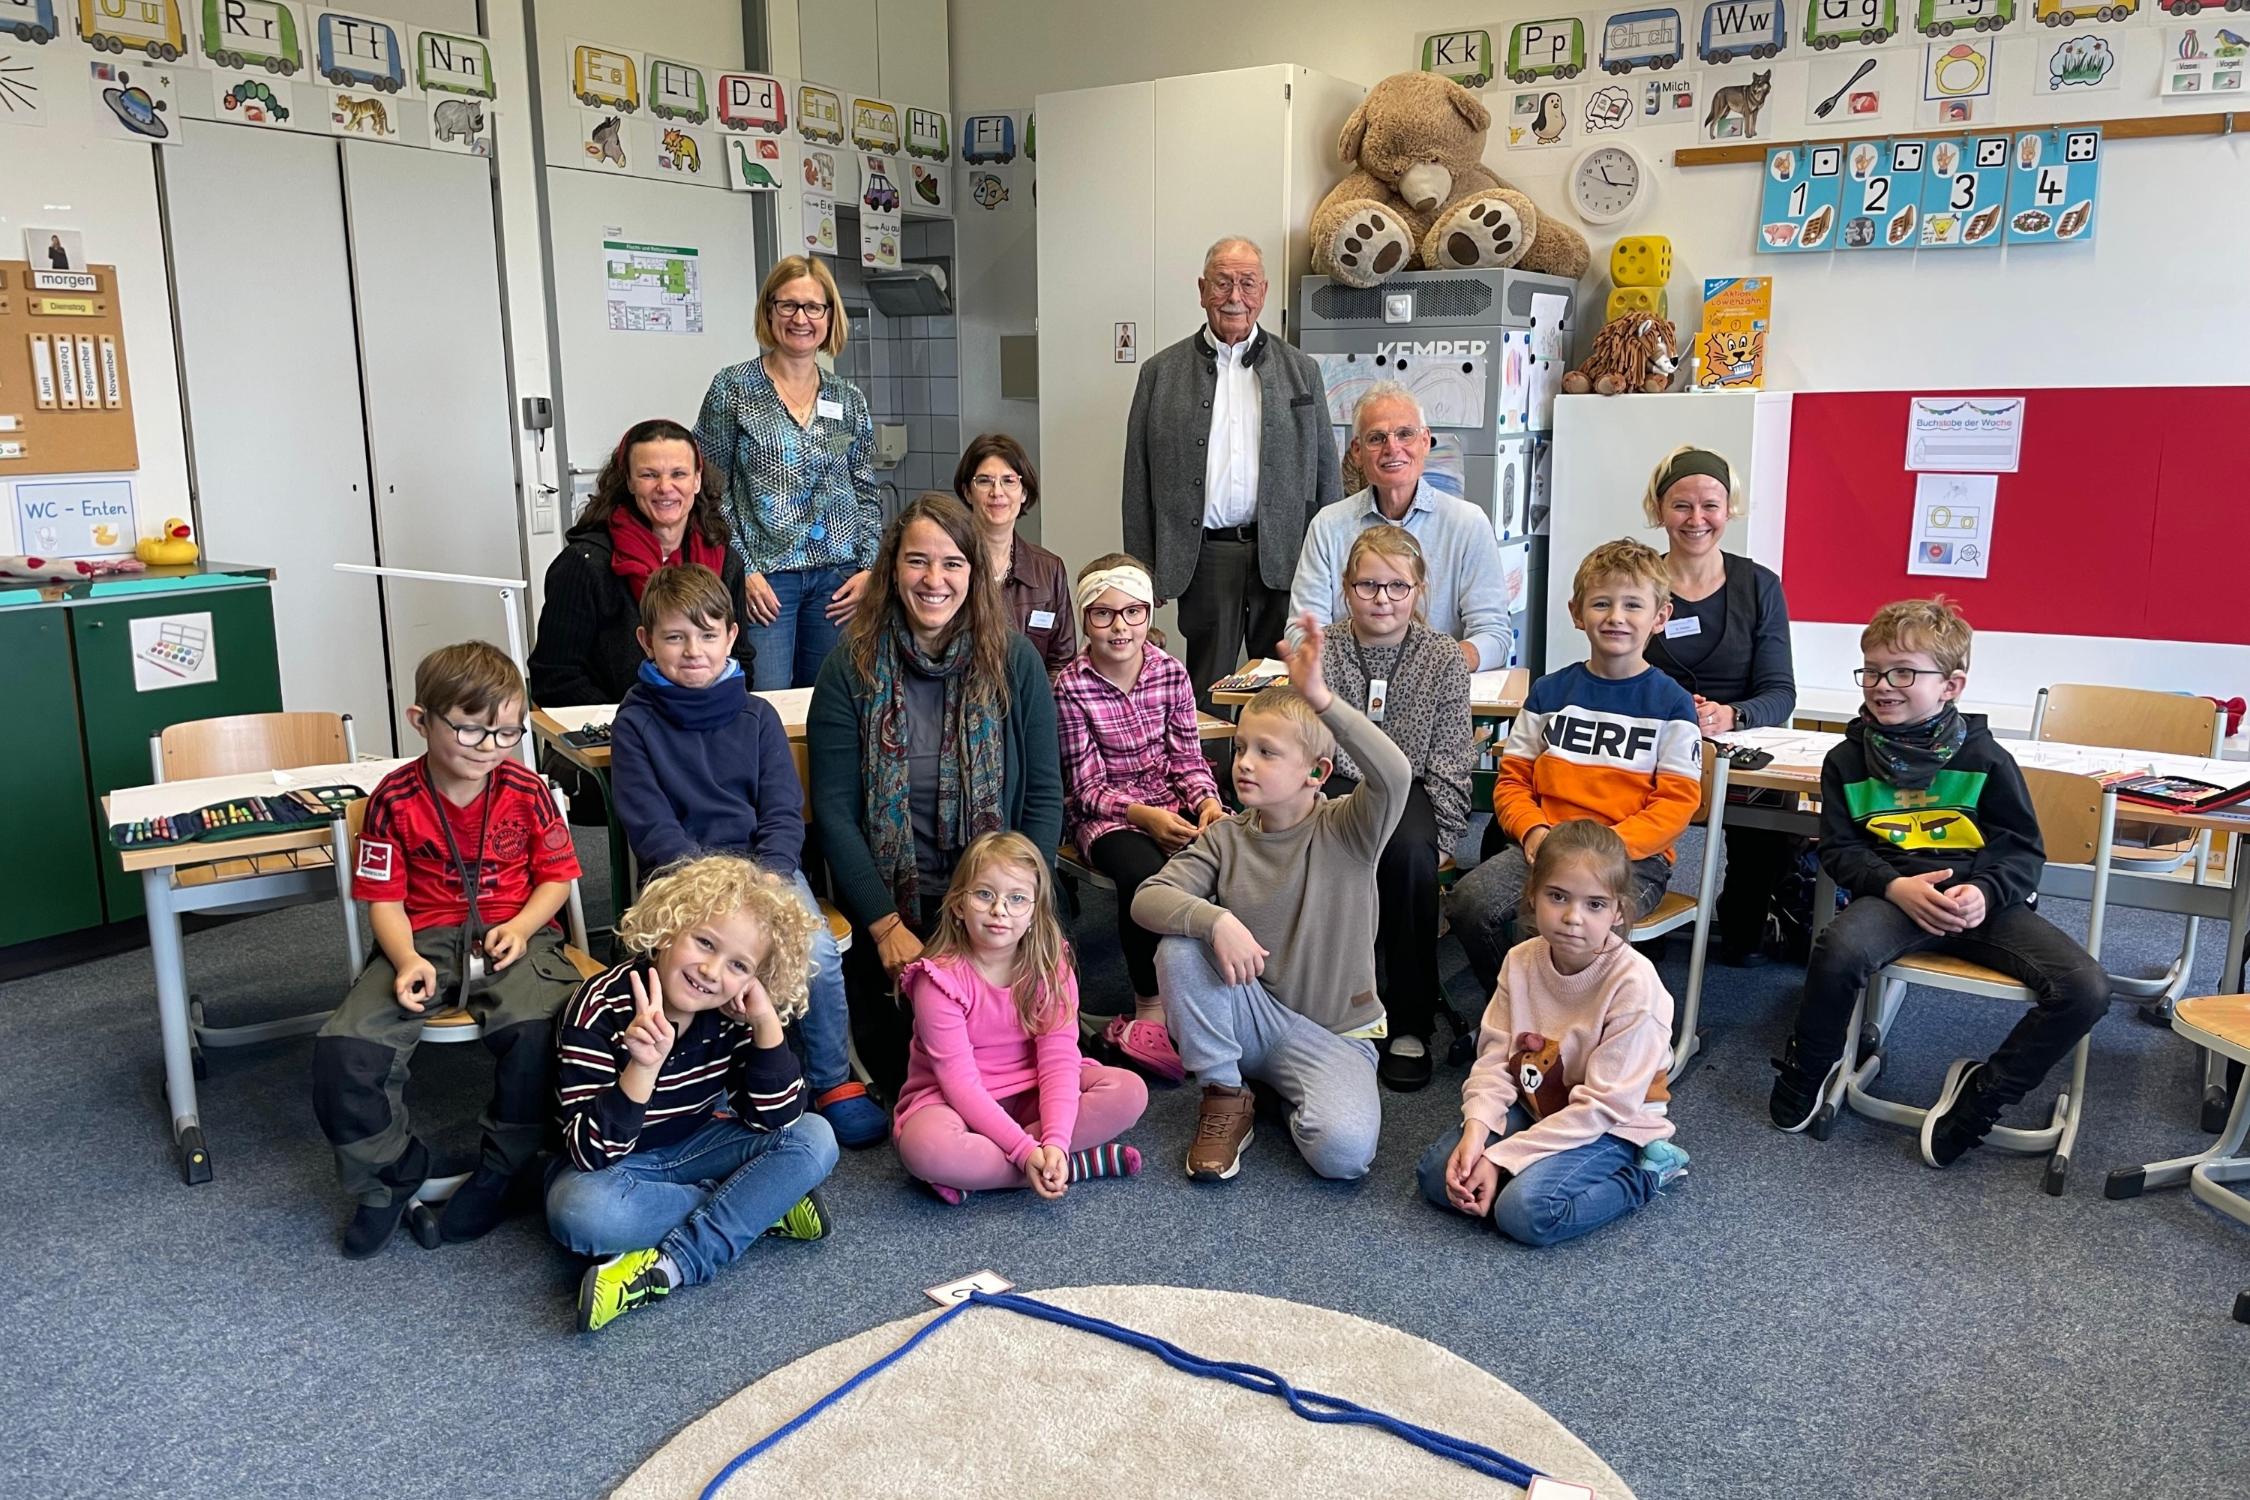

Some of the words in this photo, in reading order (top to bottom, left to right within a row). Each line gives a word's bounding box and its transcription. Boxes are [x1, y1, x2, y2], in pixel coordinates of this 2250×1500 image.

[1662, 80, 1690, 93] Milch
[1793, 182, 1807, 215] 1
[1864, 177, 1889, 212] 2
[1951, 173, 1976, 210] 3
[2037, 169, 2063, 204] 4
[42, 274, 94, 288] morgen
[50, 302, 86, 312] Dienstag
[41, 376, 51, 397] Juni
[60, 346, 73, 395] Dezember
[82, 345, 95, 397] September
[105, 349, 117, 397] November
[1916, 418, 1962, 427] Buchstabe
[1964, 419, 1979, 427] der
[1981, 419, 2012, 427] Woche
[25, 501, 58, 519] WC
[82, 500, 128, 517] Enten
[1541, 714, 1657, 761] NERF
